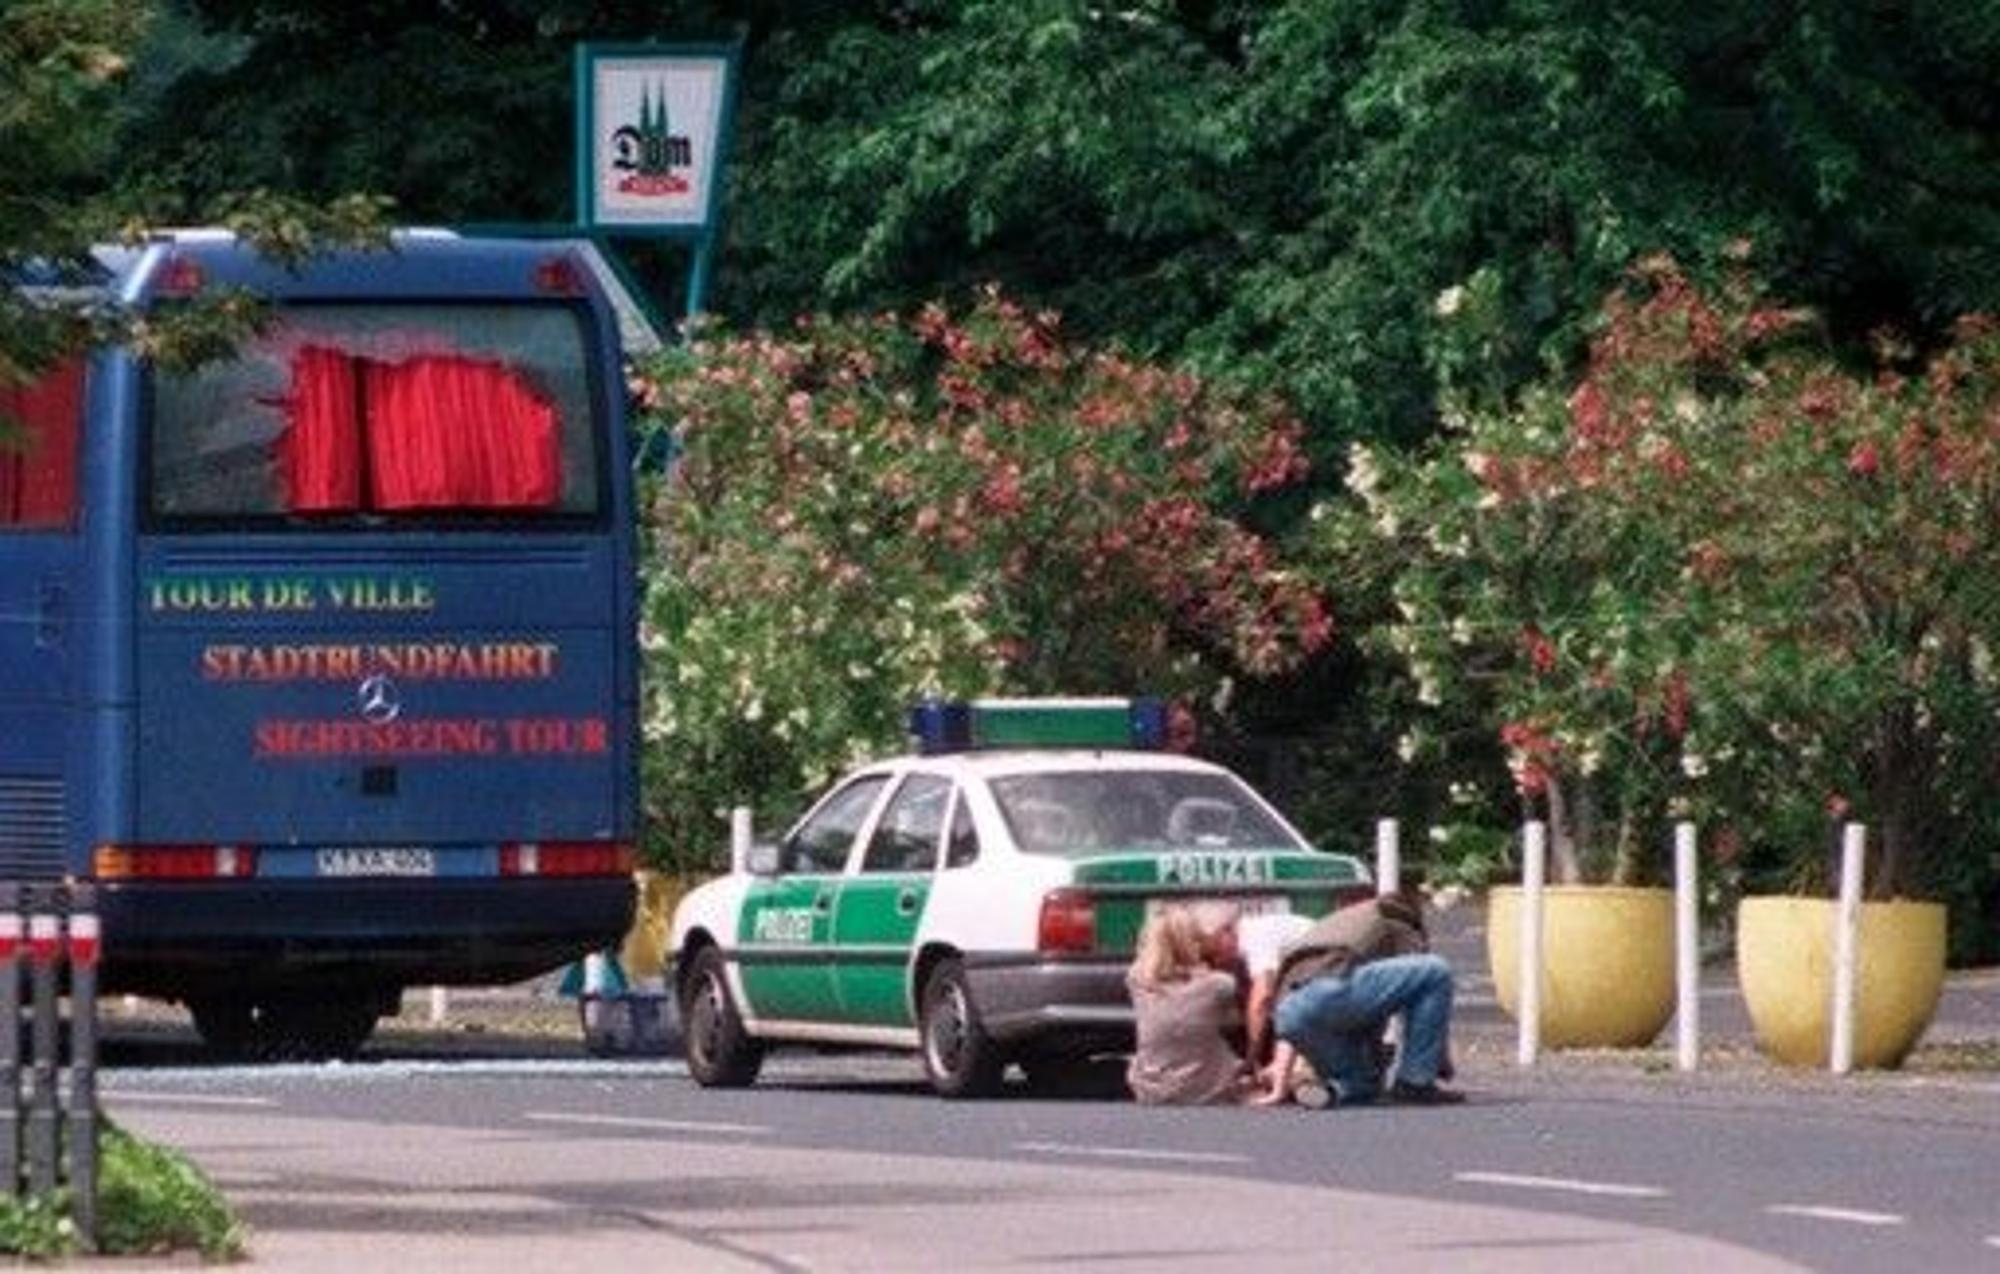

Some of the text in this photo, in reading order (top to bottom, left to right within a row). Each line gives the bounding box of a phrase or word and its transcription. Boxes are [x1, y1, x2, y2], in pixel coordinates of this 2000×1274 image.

[151, 577, 435, 609] TOUR DE VILLE
[203, 644, 558, 680] STADTRUNDFAHRT
[505, 718, 606, 752] TOUR
[1158, 852, 1275, 882] POLIZEI
